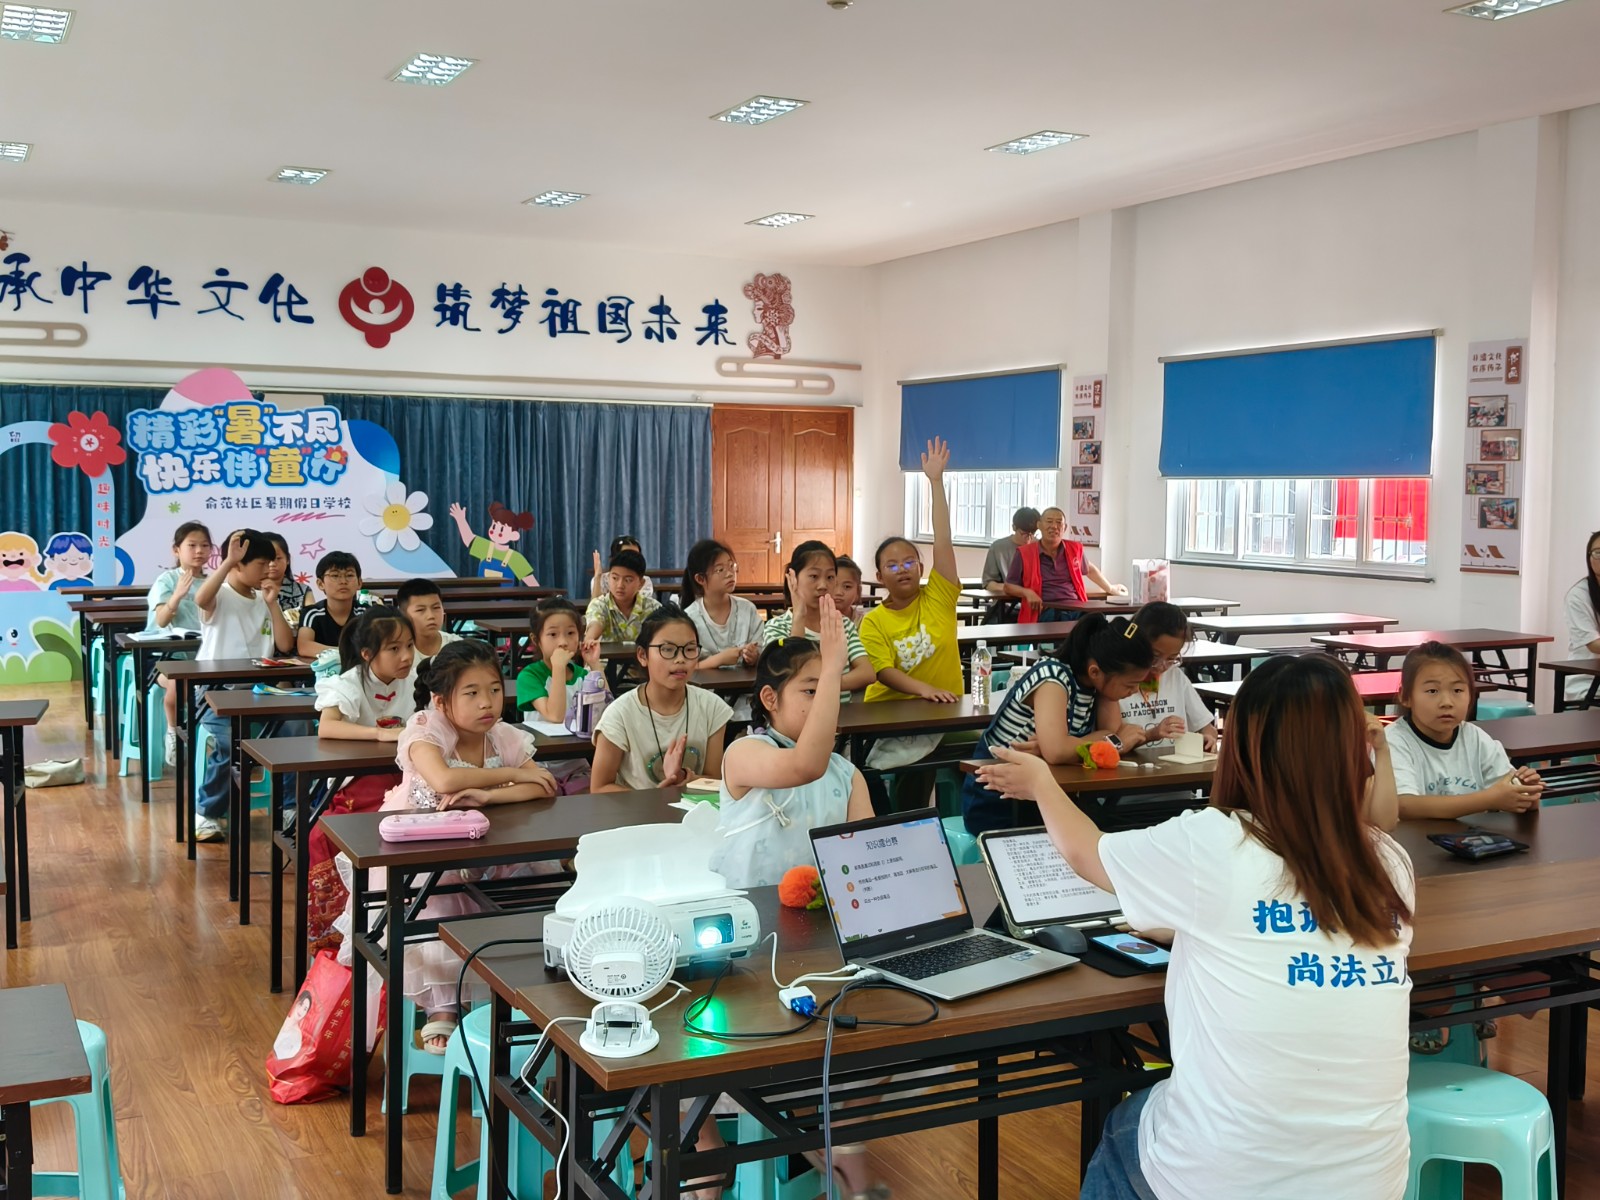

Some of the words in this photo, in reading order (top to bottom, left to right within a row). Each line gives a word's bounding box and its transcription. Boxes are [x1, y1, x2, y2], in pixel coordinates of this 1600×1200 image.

[0, 252, 314, 324] 承中华文化
[434, 281, 737, 346] 筑梦祖国未来
[97, 483, 110, 547] 趣味时光
[1121, 711, 1132, 719] DU
[1130, 702, 1140, 710] LA
[1140, 699, 1168, 709] MAISON
[1287, 952, 1411, 988] 尚法立
